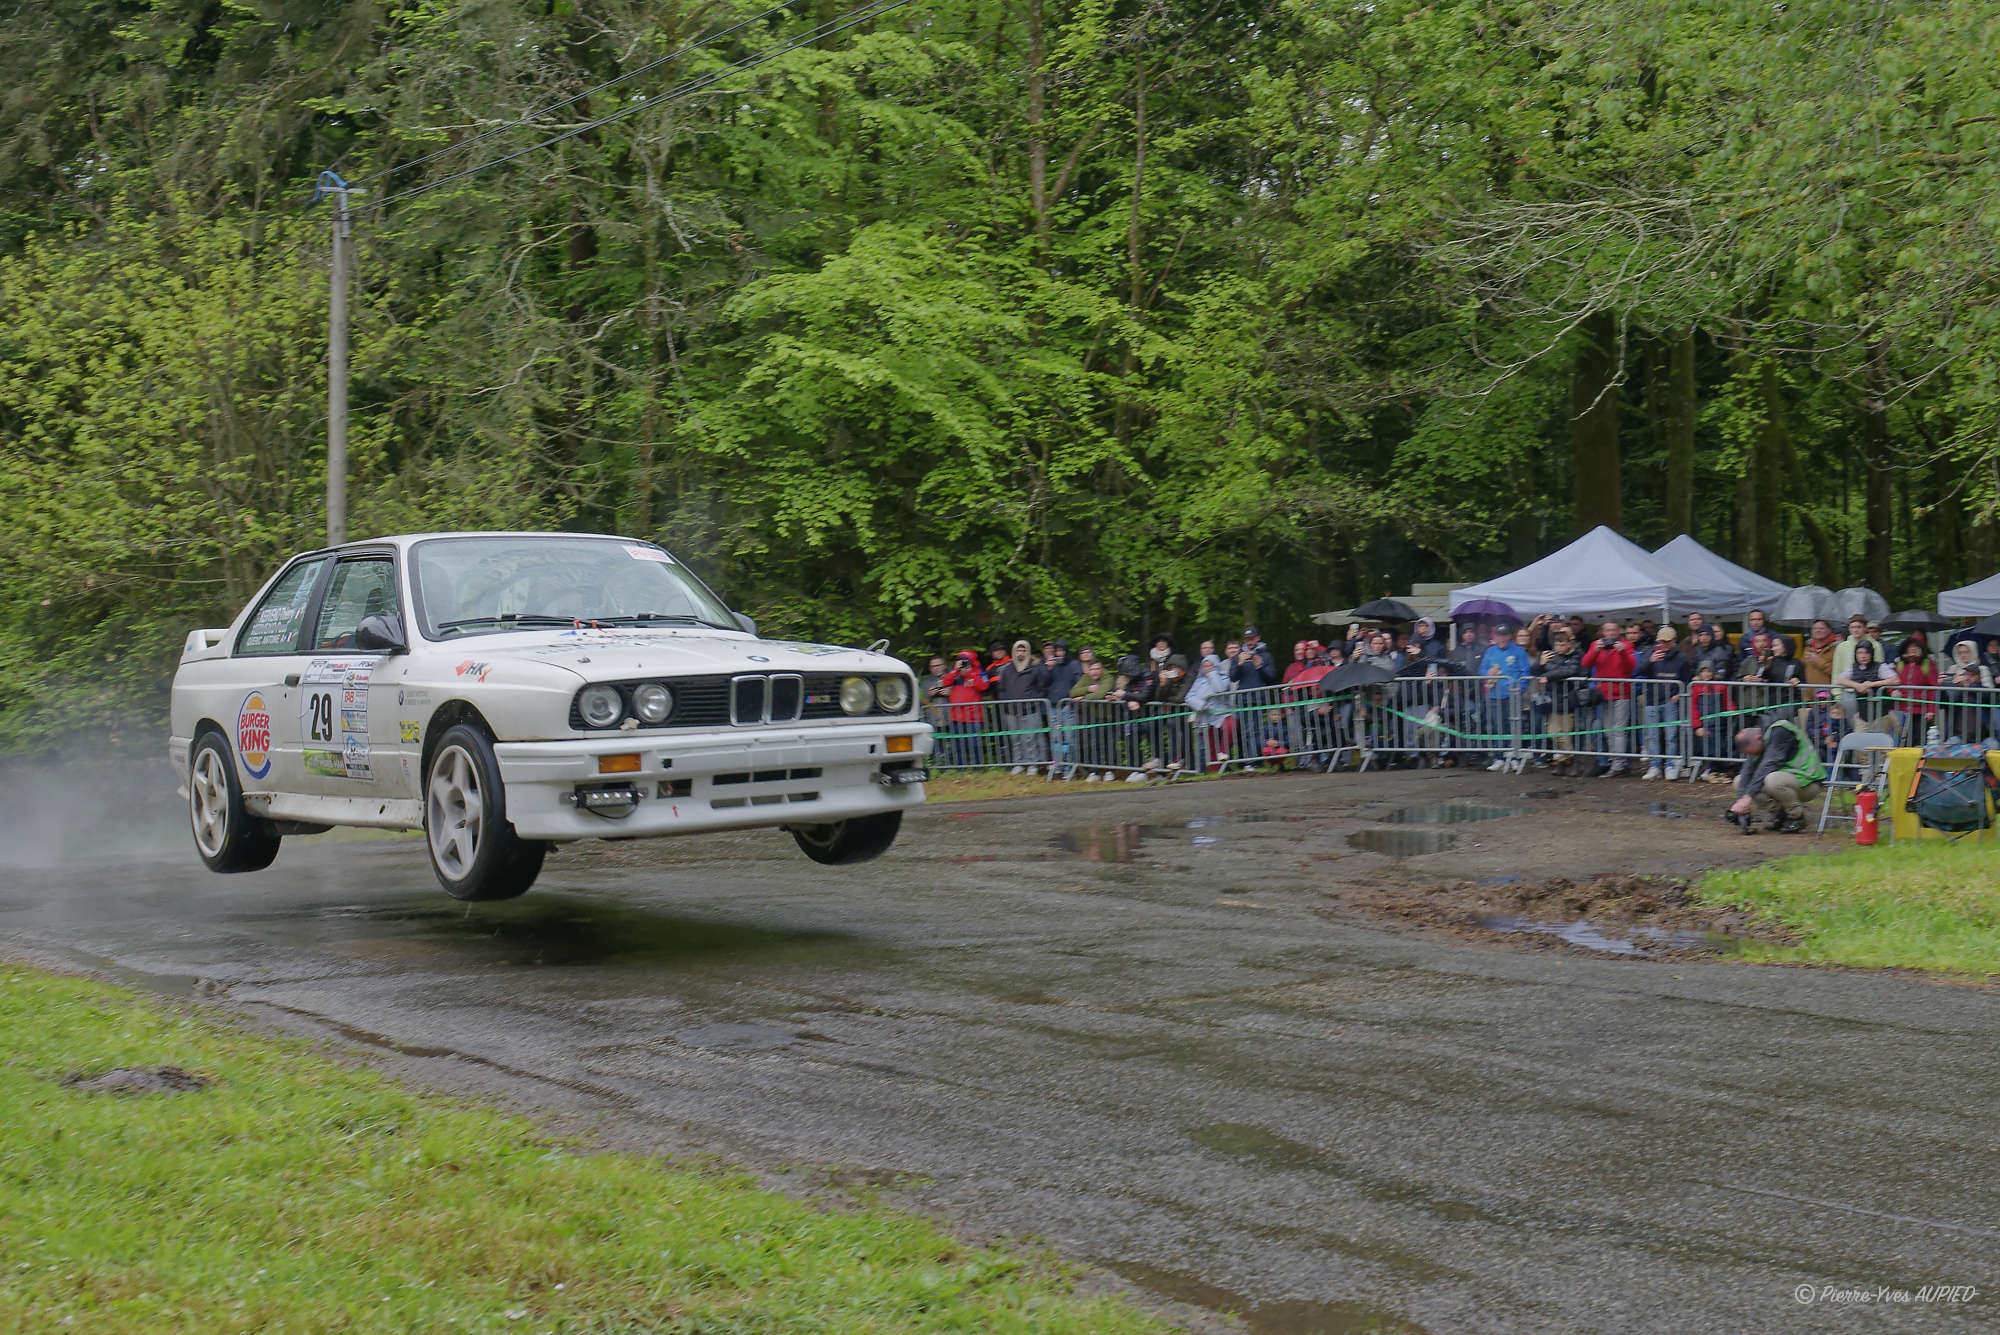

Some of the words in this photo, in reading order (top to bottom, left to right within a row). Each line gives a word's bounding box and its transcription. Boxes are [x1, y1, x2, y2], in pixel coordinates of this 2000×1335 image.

[240, 713, 270, 730] BURGER
[310, 693, 332, 741] 29
[240, 729, 270, 753] KING
